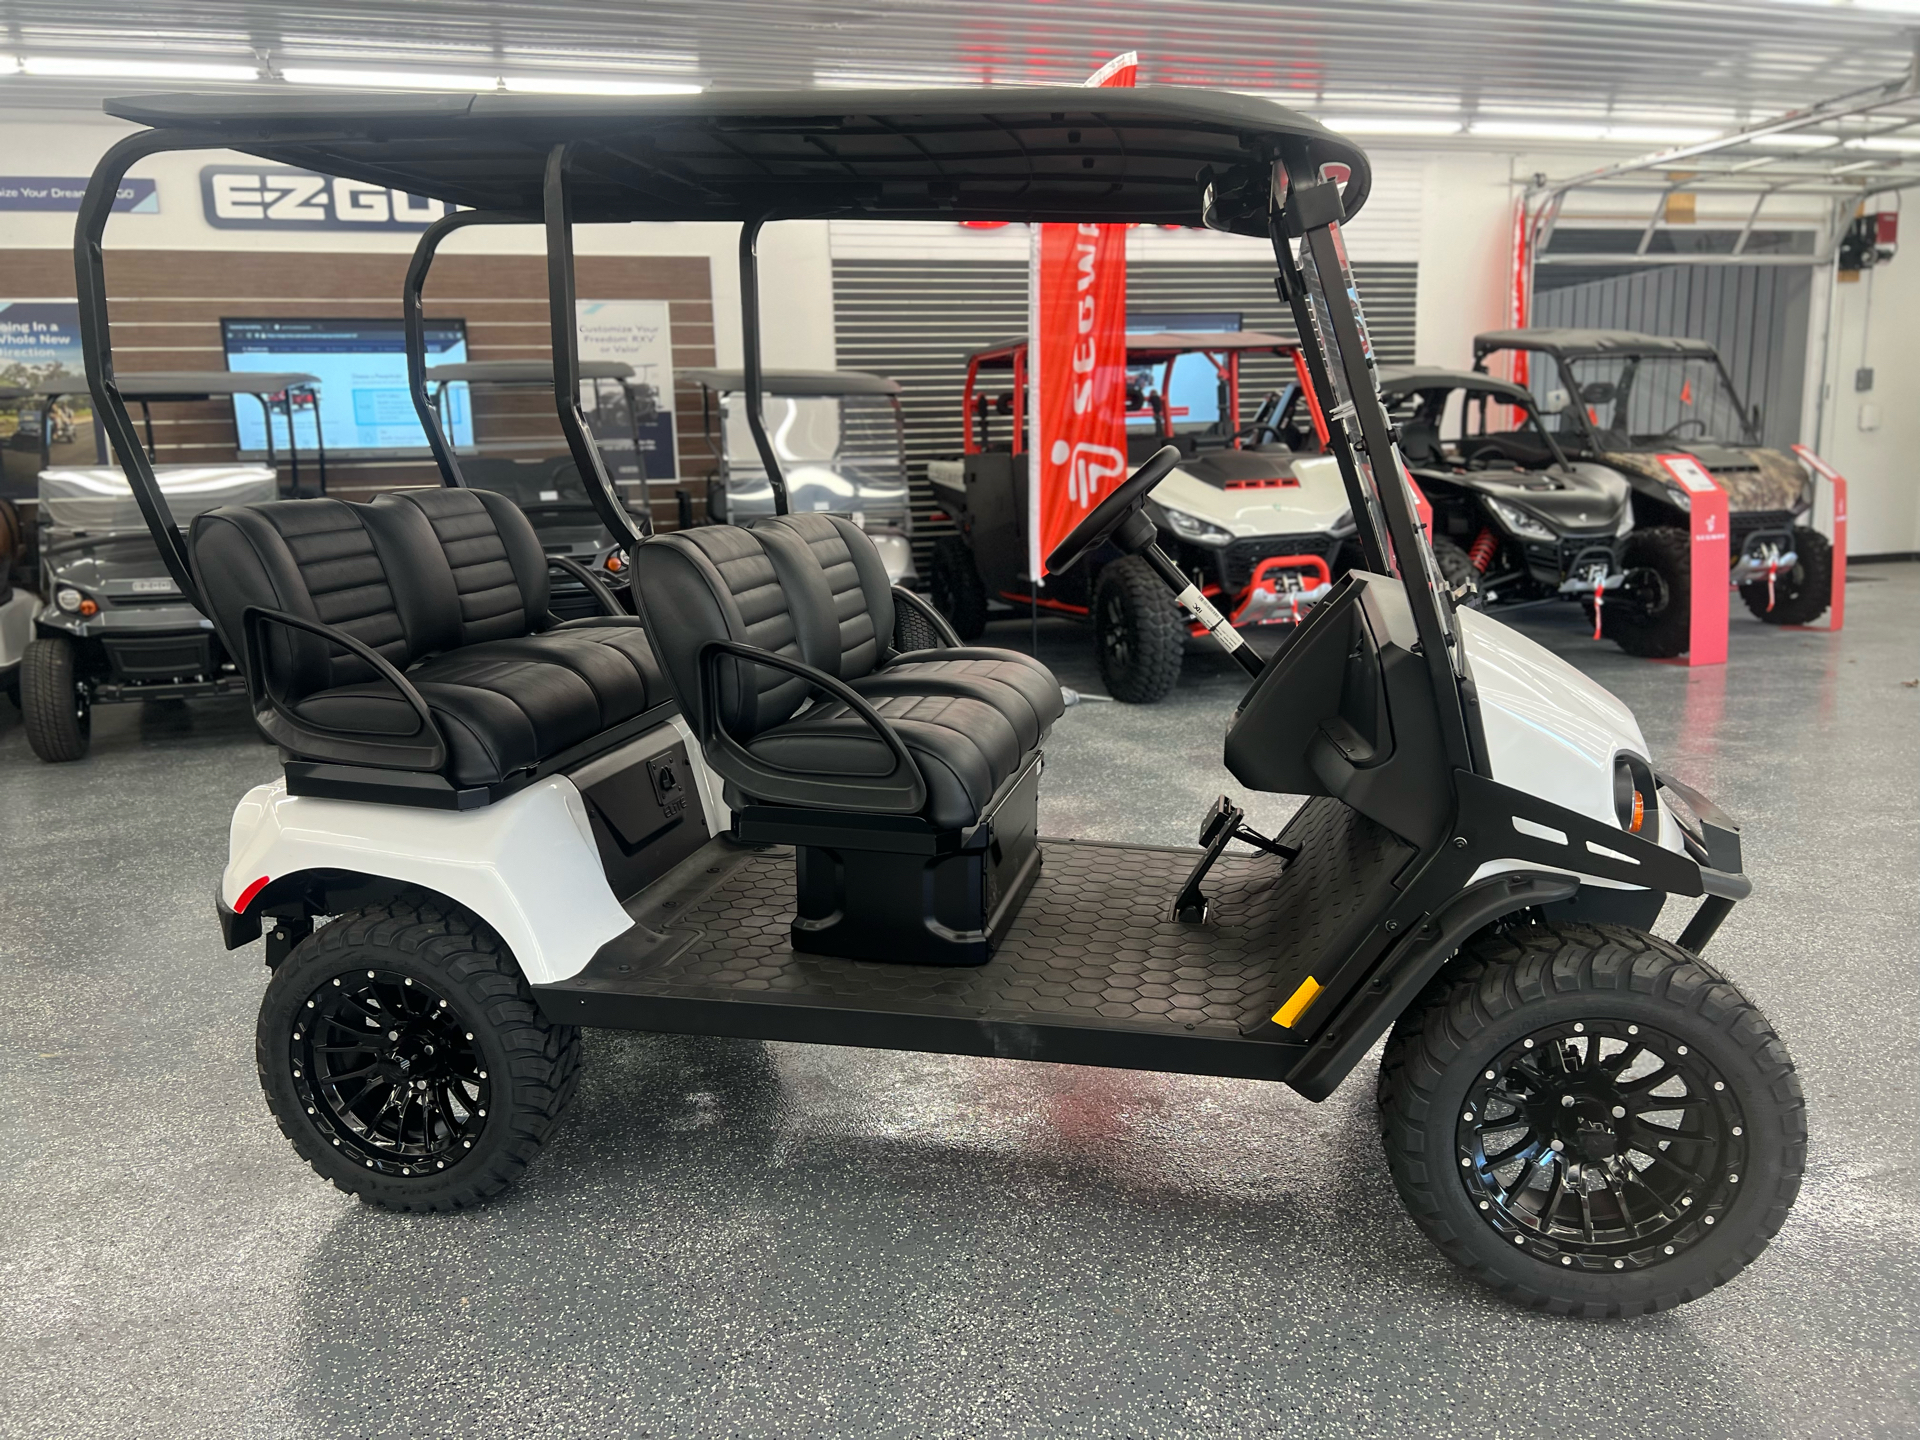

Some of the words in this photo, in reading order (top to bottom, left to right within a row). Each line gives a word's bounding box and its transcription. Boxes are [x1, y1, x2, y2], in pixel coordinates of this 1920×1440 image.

[0, 188, 18, 198] ize
[20, 188, 48, 198] Your
[33, 321, 47, 332] In
[50, 323, 59, 332] a
[579, 325, 632, 333] Customize
[636, 325, 659, 333] Your
[40, 334, 71, 345] New
[663, 796, 687, 818] ELITE
